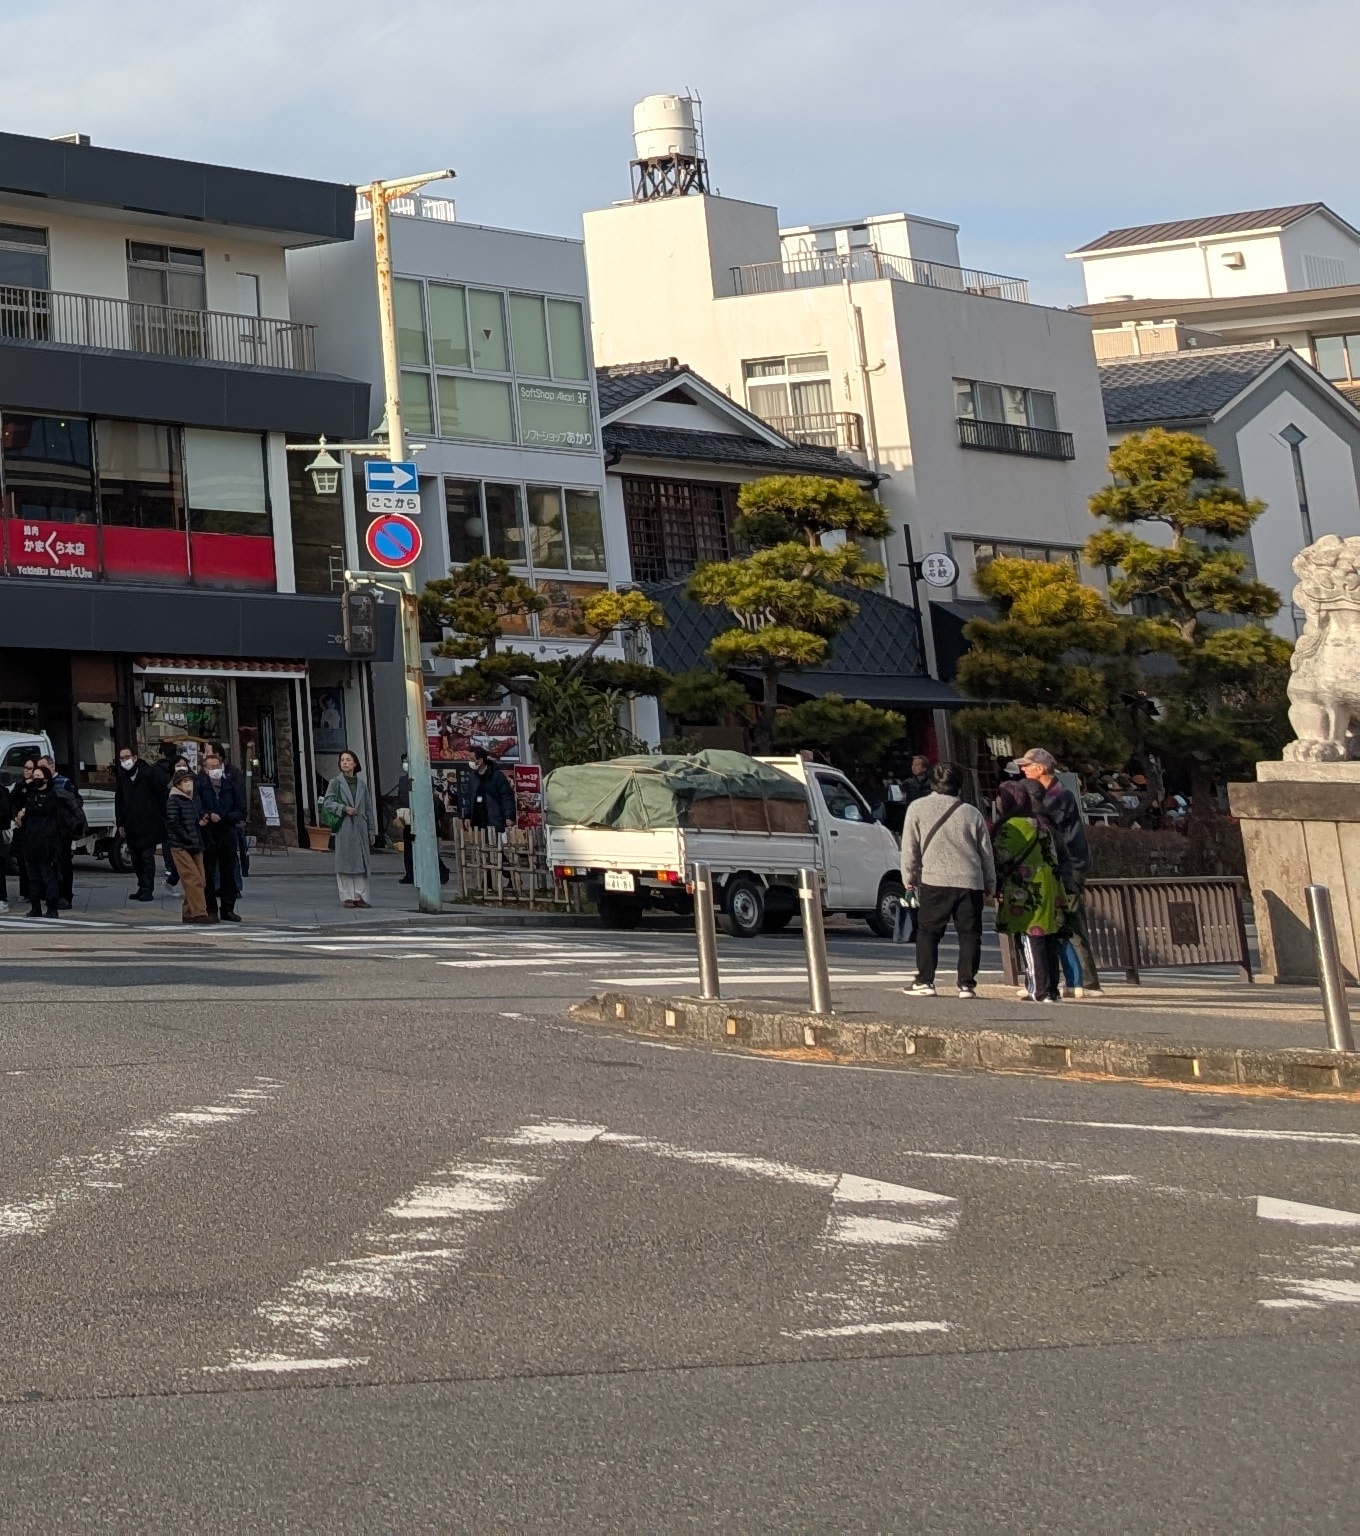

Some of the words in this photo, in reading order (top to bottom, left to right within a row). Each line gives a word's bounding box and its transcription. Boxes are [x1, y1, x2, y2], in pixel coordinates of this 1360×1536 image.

[521, 386, 555, 401] SoftShop
[577, 391, 588, 404] 3F
[371, 497, 417, 510] ここから
[23, 531, 85, 564] かまくら本店
